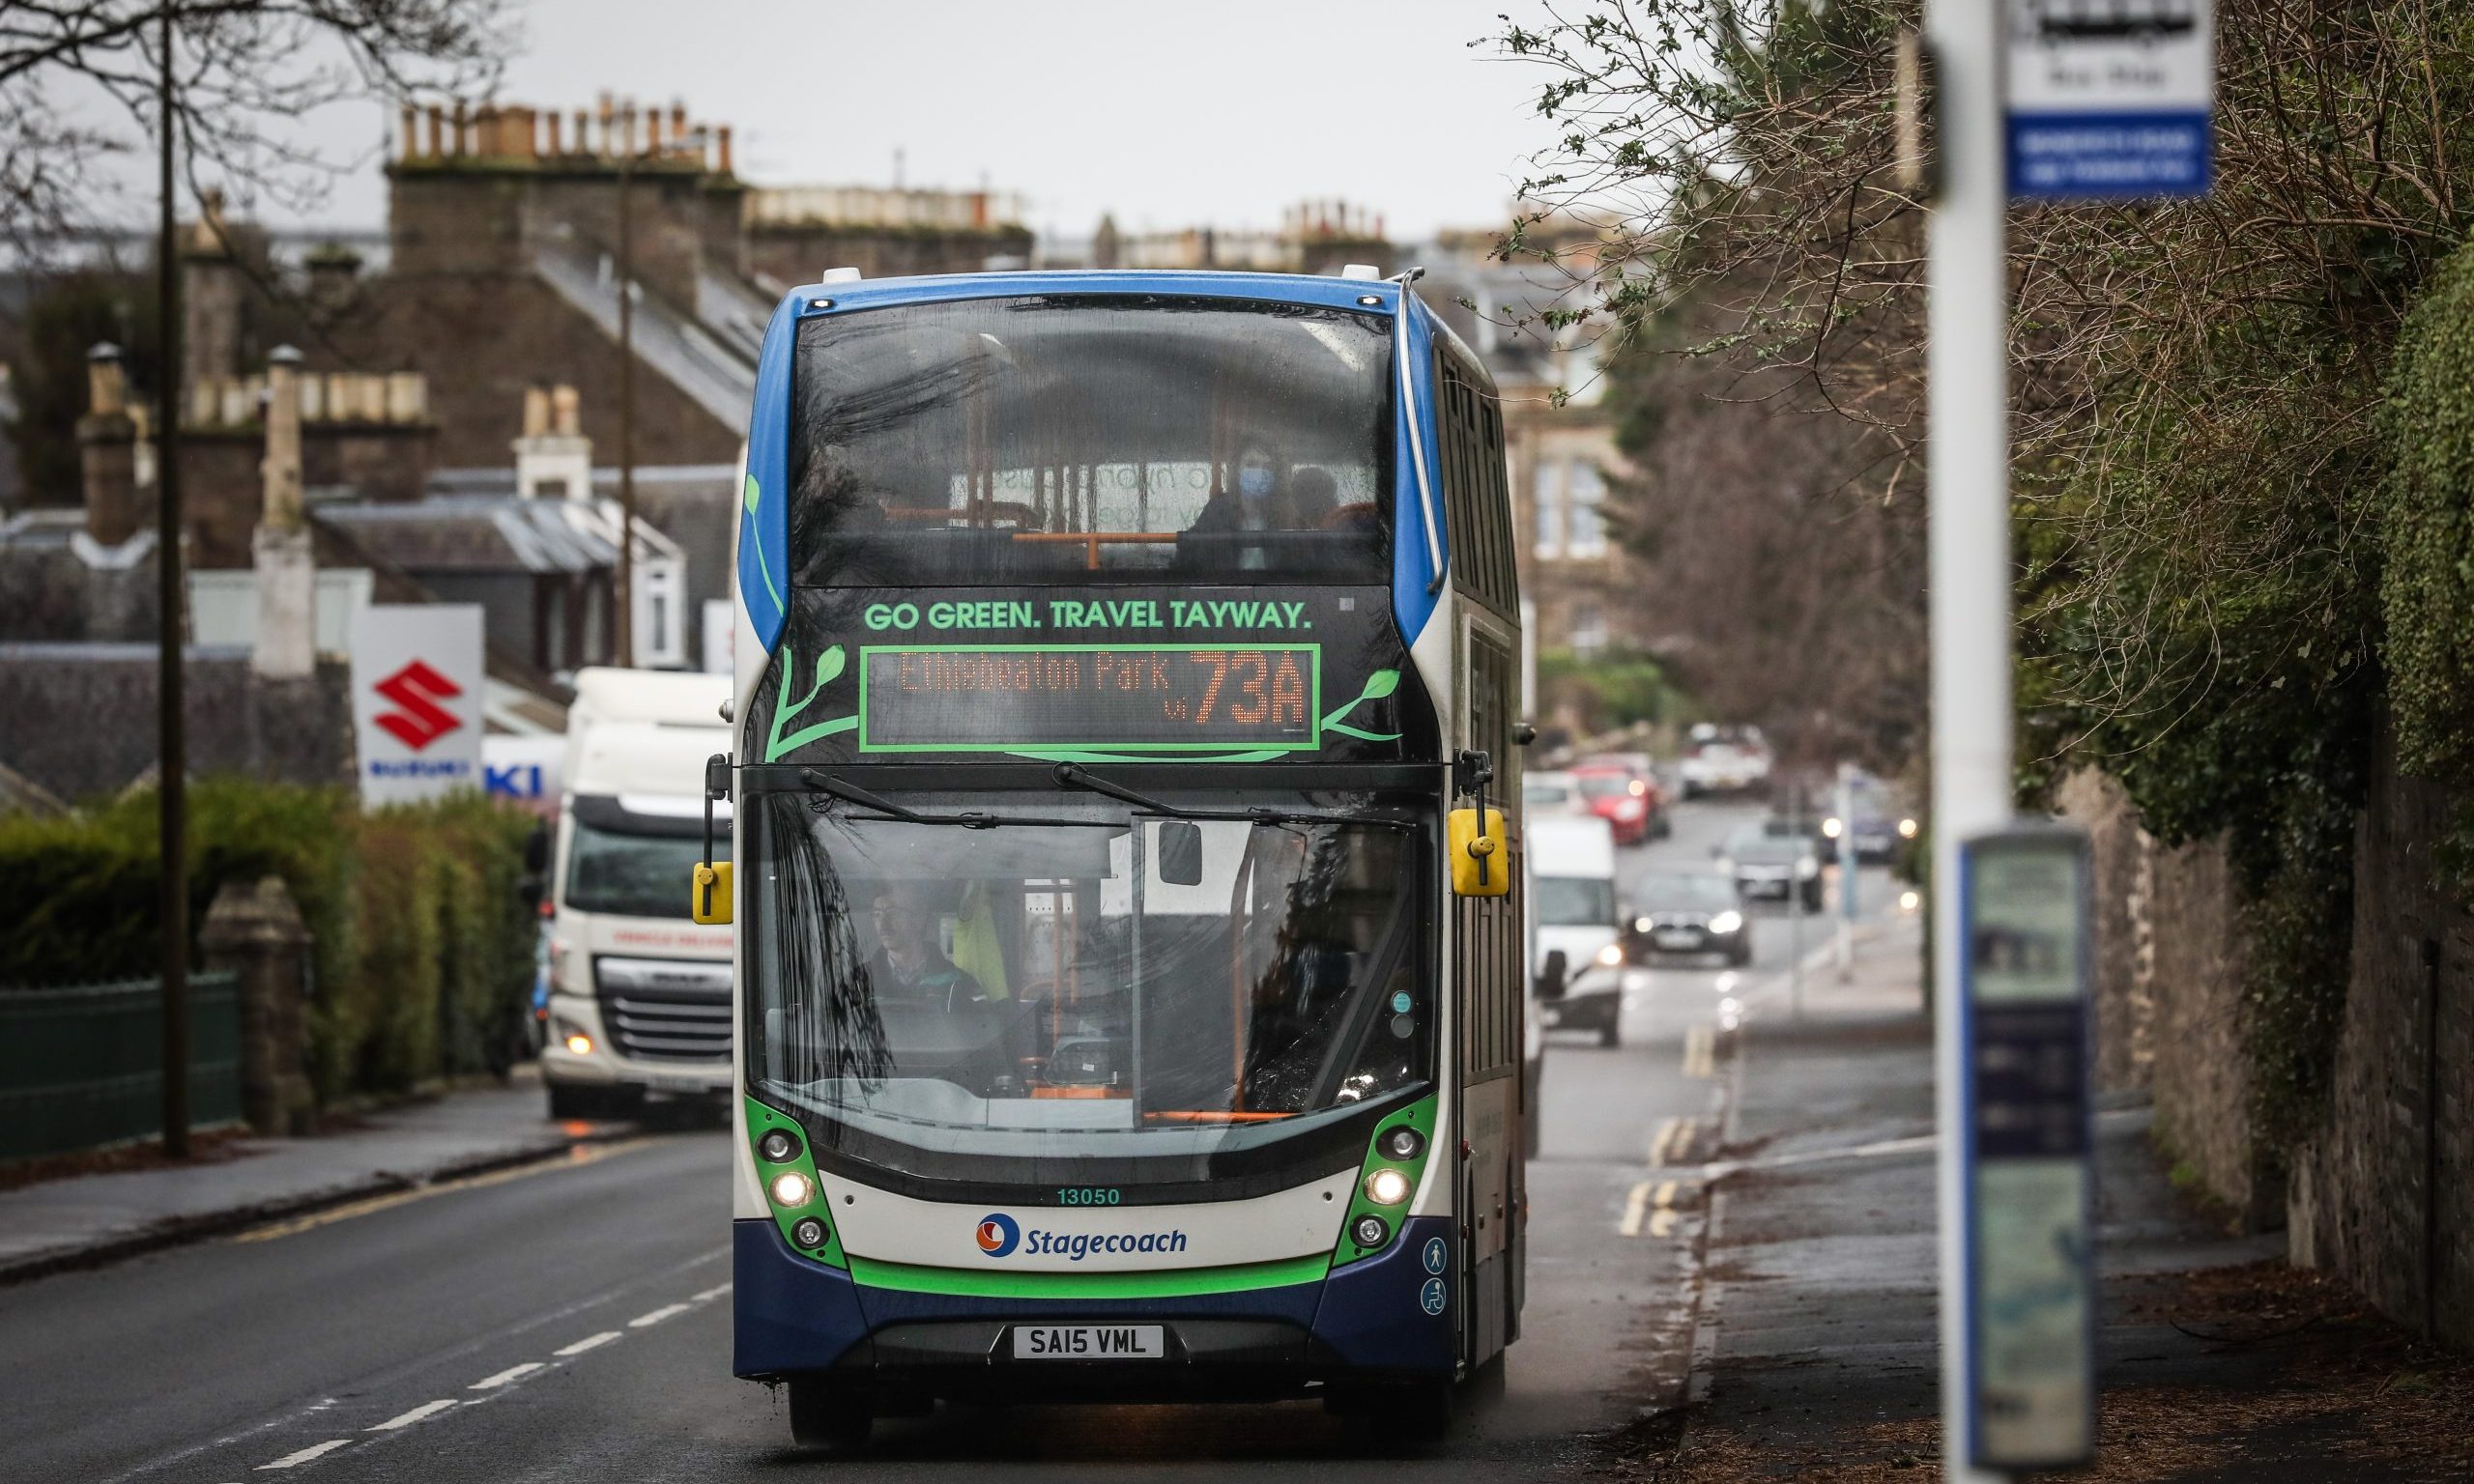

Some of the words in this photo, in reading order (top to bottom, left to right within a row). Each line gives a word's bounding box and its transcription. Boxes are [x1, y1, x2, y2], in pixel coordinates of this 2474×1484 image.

[864, 603, 920, 630] GO
[928, 601, 1041, 629] GREEN.
[1050, 601, 1164, 629] TRAVEL
[1169, 600, 1312, 629] TAYWAY.
[1097, 651, 1168, 690] Park
[1190, 650, 1303, 723] 73A
[1056, 1188, 1120, 1205] 13050
[1025, 1229, 1188, 1261] Stagecoach
[1030, 1329, 1088, 1354] SA15
[1097, 1329, 1146, 1353] VML
